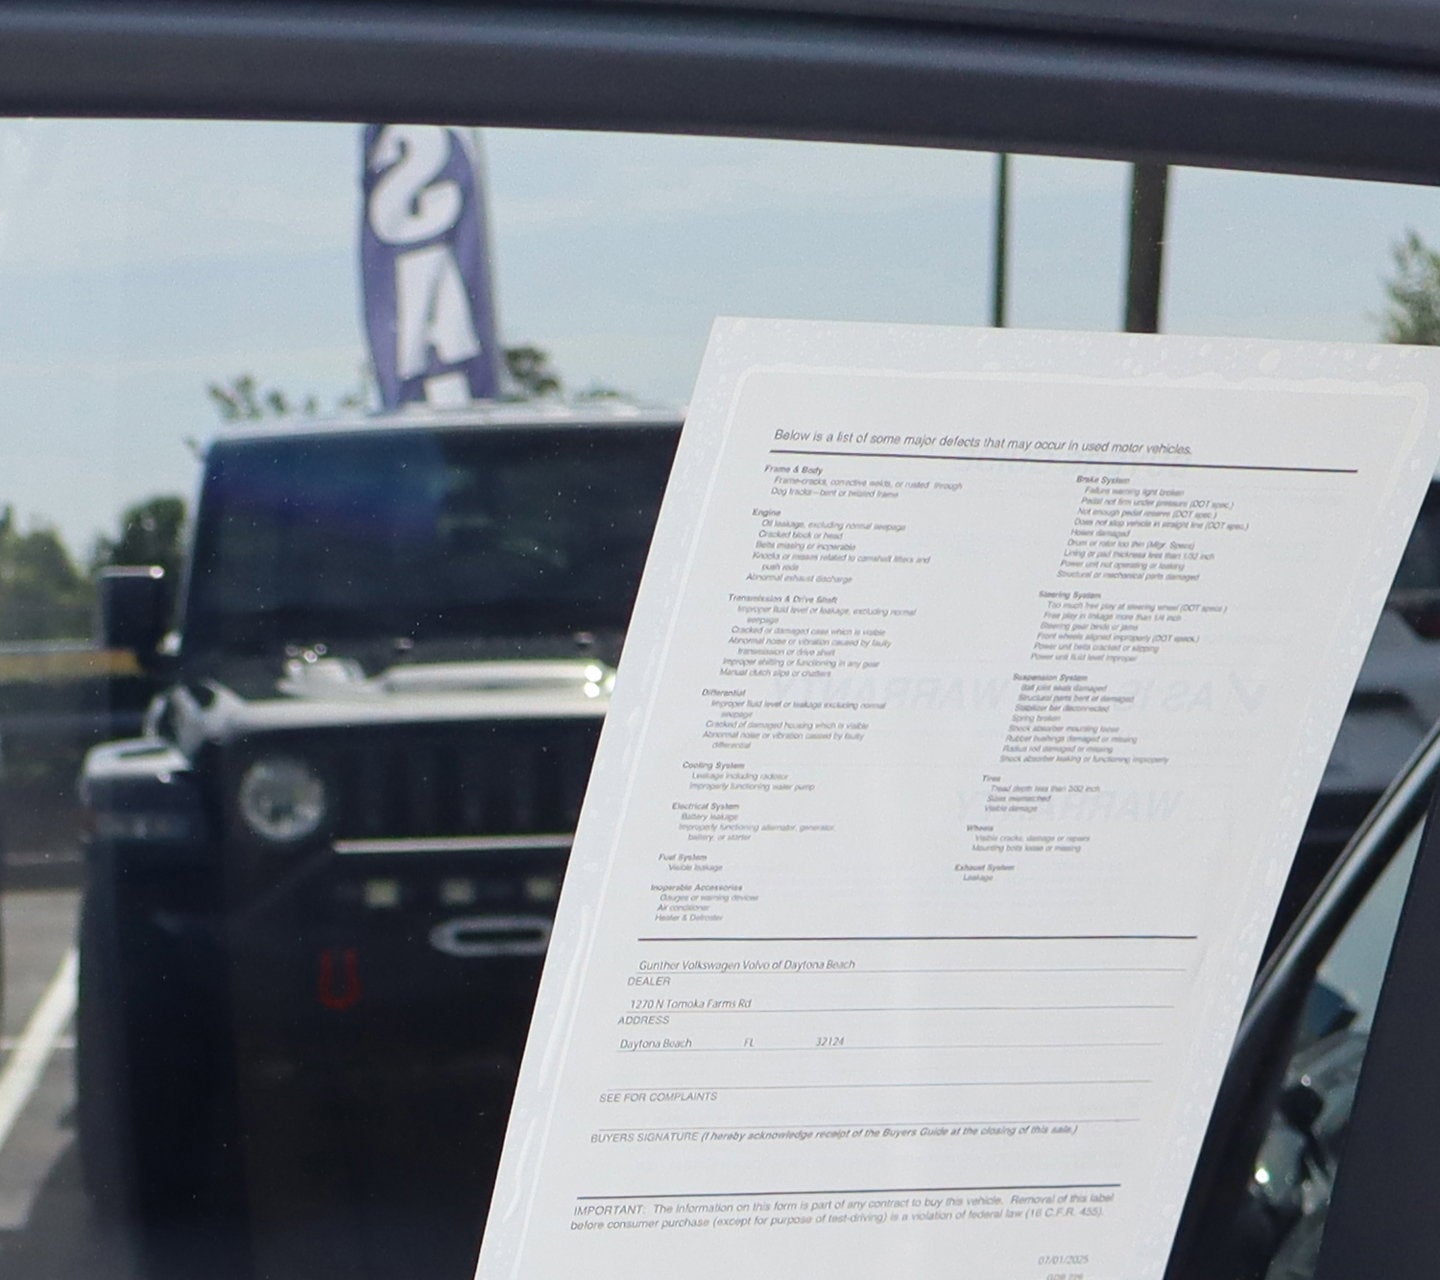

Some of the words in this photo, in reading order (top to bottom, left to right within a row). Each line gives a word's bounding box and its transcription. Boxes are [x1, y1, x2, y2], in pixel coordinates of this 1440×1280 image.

[773, 428, 810, 441] Below
[812, 430, 824, 442] is
[825, 432, 834, 442] a
[836, 431, 854, 443] list
[855, 431, 868, 443] of
[869, 434, 901, 444] some
[902, 435, 936, 448] major
[938, 434, 981, 447] defects
[982, 436, 1006, 448] that
[1006, 439, 1032, 452] may
[1033, 439, 1066, 450] occur
[1067, 439, 1080, 450] in
[1081, 439, 1110, 451] used
[1111, 440, 1144, 452] motor
[1145, 441, 1193, 454] vehicles.
[638, 960, 680, 970] Gunther
[680, 960, 741, 973] Volkswagen
[741, 959, 771, 969] Volvo
[771, 959, 782, 969] of
[782, 959, 825, 972] Daytona
[825, 959, 856, 969] Beach
[626, 976, 671, 985] DEALER
[630, 999, 654, 1009] 1270
[655, 999, 664, 1009] N
[666, 999, 705, 1009] Tomoka
[706, 999, 737, 1008] Farms
[737, 998, 752, 1008] Rd
[617, 1015, 670, 1024] ADDRESS
[618, 1039, 661, 1051] Daytona
[662, 1038, 693, 1048] Beach
[743, 1038, 754, 1046] FL
[816, 1036, 845, 1046] 32124
[599, 1093, 621, 1102] SEE
[622, 1092, 647, 1102] FOR
[648, 1091, 718, 1102] COMPLAINTS
[589, 1133, 634, 1143] BUYERS
[636, 1132, 698, 1142] SIGNATURE
[709, 1131, 746, 1142] hereby
[746, 1129, 814, 1142] acknowledge
[814, 1129, 850, 1140] receipt
[851, 1128, 863, 1137] of
[863, 1128, 881, 1137] the
[881, 1127, 918, 1139] Buyers
[919, 1127, 949, 1136] Guide
[950, 1126, 961, 1135] at
[962, 1126, 979, 1135] the
[979, 1125, 1017, 1137] closing
[1017, 1125, 1030, 1134] of
[1030, 1125, 1049, 1134] this
[573, 1204, 645, 1216] IMPORTANT:
[653, 1204, 673, 1213] The
[735, 1203, 750, 1211] on
[752, 1201, 771, 1211] this
[773, 1201, 798, 1210] form
[799, 1200, 809, 1210] is
[809, 1200, 832, 1212] part
[833, 1199, 845, 1209] of
[846, 1201, 866, 1211] any
[867, 1198, 910, 1208] contract
[910, 1197, 922, 1207] to
[922, 1197, 943, 1209] buy
[944, 1196, 964, 1206] this
[965, 1195, 1005, 1205] vehicle.
[1010, 1194, 1055, 1204] Removal
[1057, 1194, 1068, 1203] of
[1069, 1193, 1088, 1202] this
[1089, 1193, 1115, 1202] label
[569, 1220, 605, 1230] before
[606, 1220, 658, 1229] consumer
[660, 1217, 710, 1230] purchase
[711, 1216, 751, 1228] (except
[753, 1216, 767, 1225] for
[769, 1216, 812, 1227] purpose
[814, 1214, 826, 1223] of
[826, 1212, 888, 1225] test-driving)
[889, 1212, 899, 1221] is
[910, 1211, 953, 1220] violation
[954, 1210, 966, 1219] of
[967, 1209, 1003, 1219] federal
[1004, 1209, 1023, 1218] law
